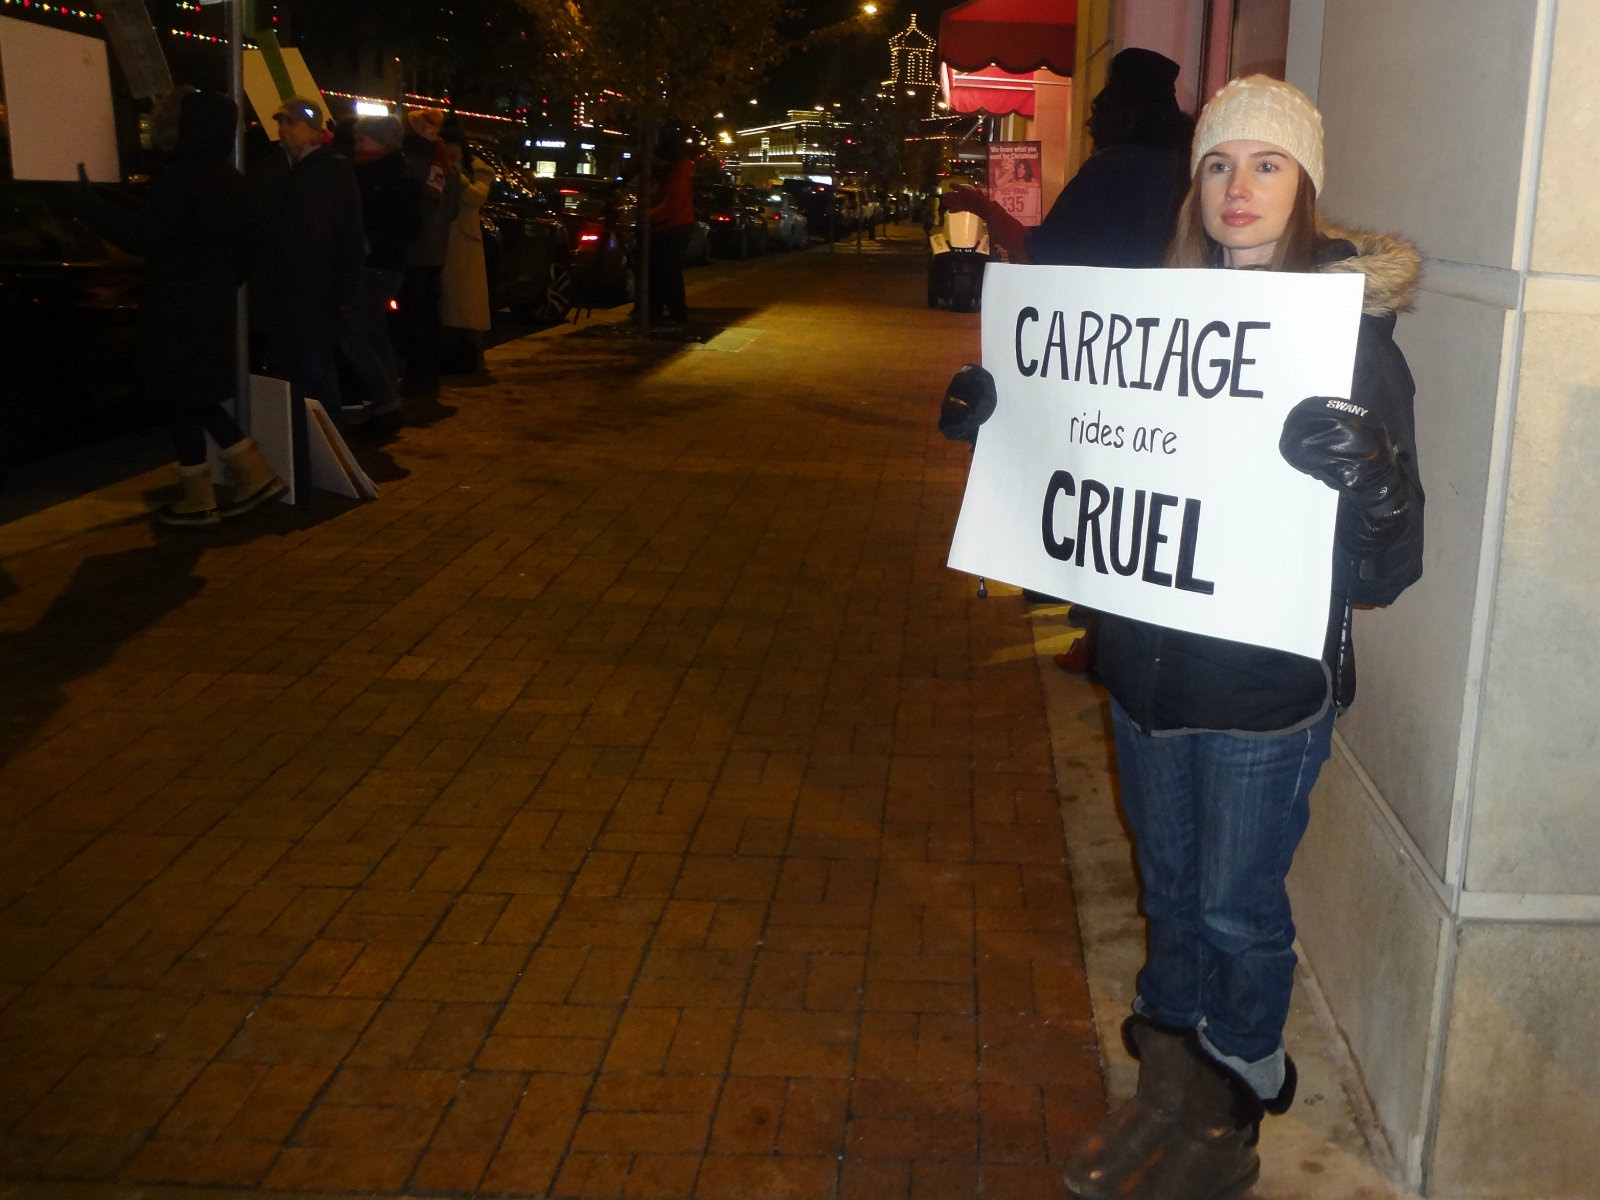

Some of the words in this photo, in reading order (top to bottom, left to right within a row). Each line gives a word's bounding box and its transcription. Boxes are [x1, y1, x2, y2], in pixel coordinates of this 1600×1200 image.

[1027, 146, 1037, 154] you
[1002, 196, 1024, 213] $35
[1016, 307, 1270, 398] CARRIAGE
[1326, 399, 1369, 417] SWANY
[1070, 410, 1124, 448] rides
[1133, 427, 1177, 454] are
[1041, 470, 1215, 595] CRUEL
